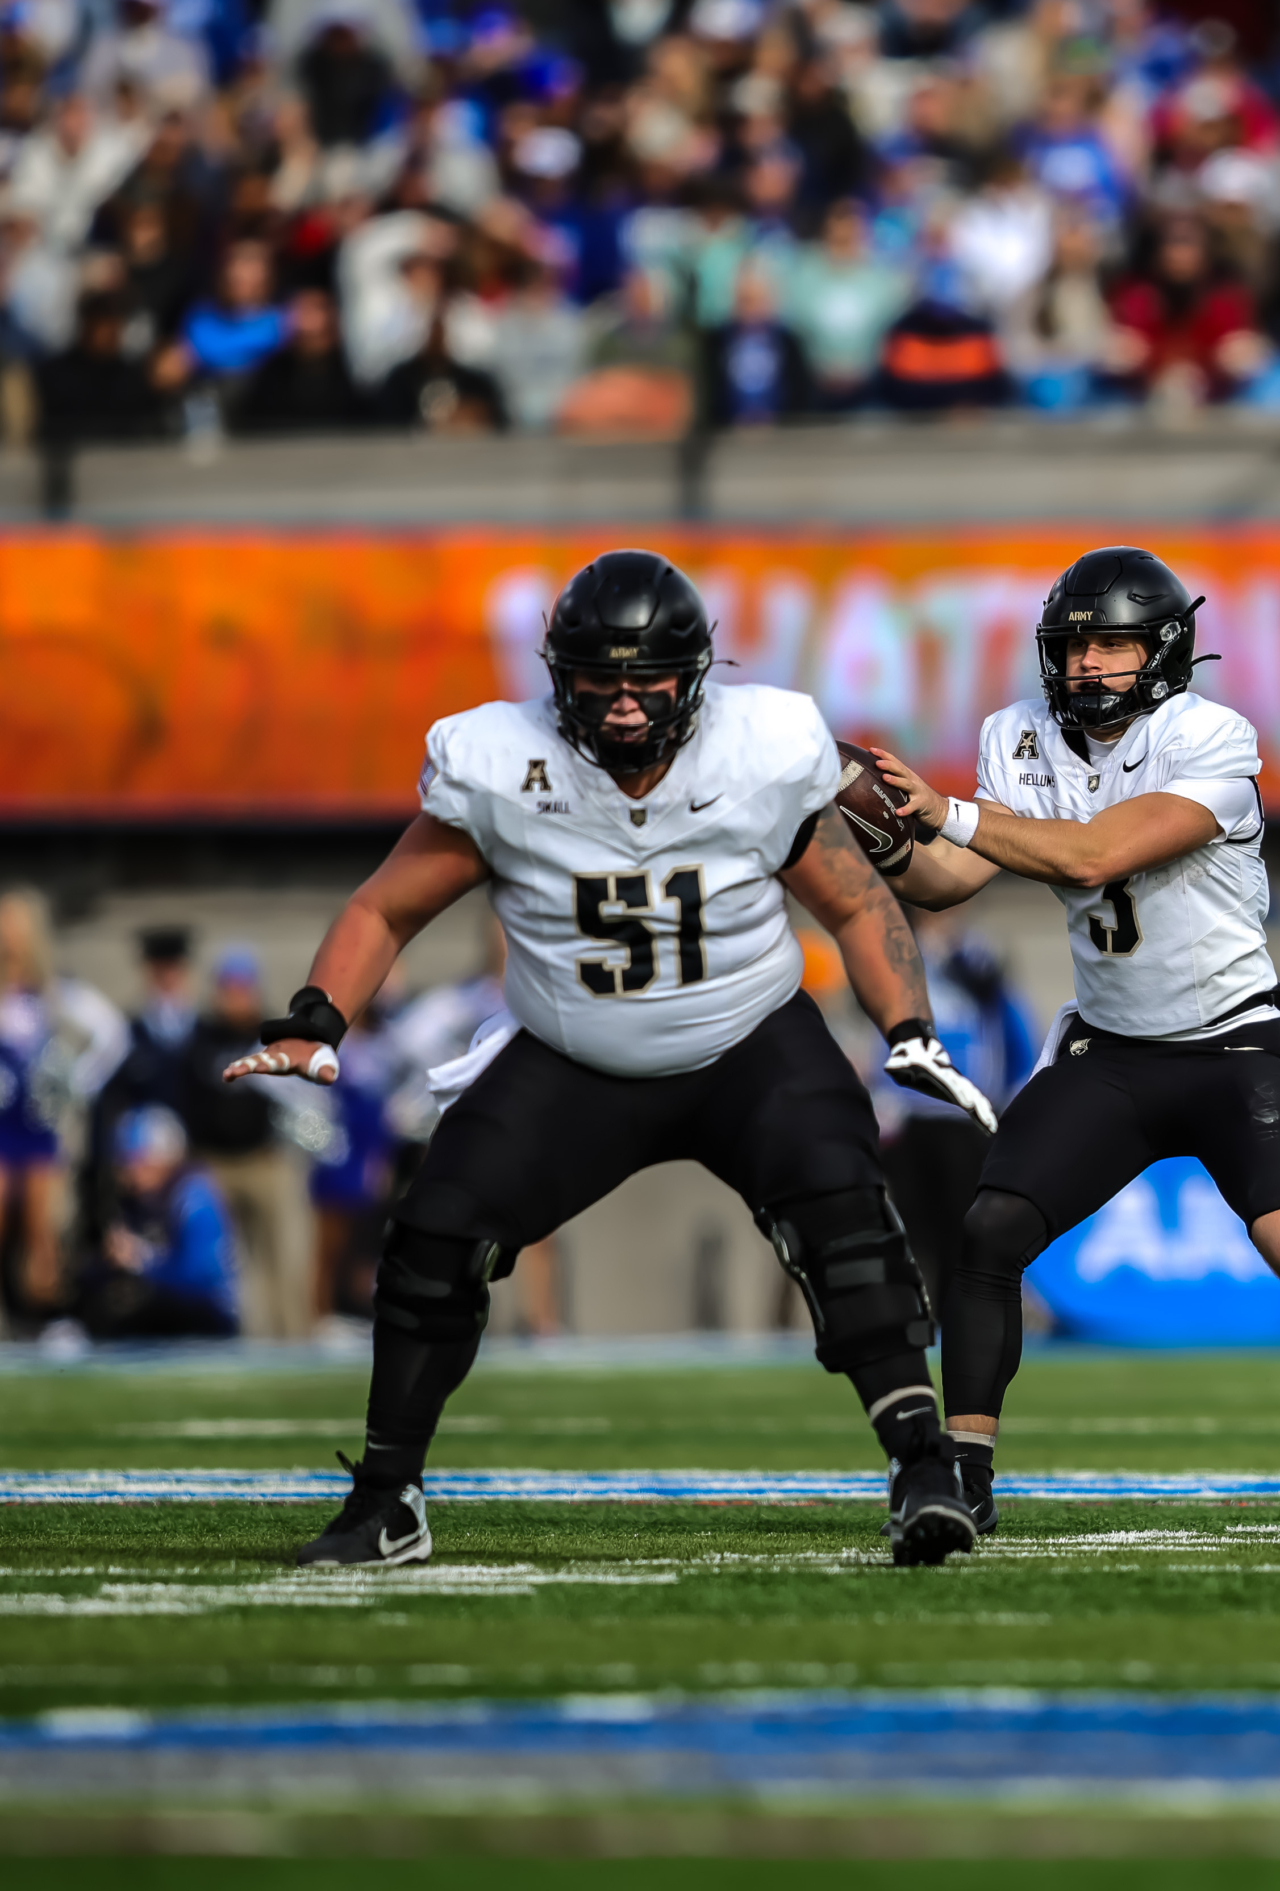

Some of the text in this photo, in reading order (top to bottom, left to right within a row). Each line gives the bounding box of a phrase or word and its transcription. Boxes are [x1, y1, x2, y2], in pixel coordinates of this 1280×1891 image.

[1068, 611, 1093, 621] ARMY
[609, 646, 639, 659] ARMY
[573, 864, 707, 999] 51
